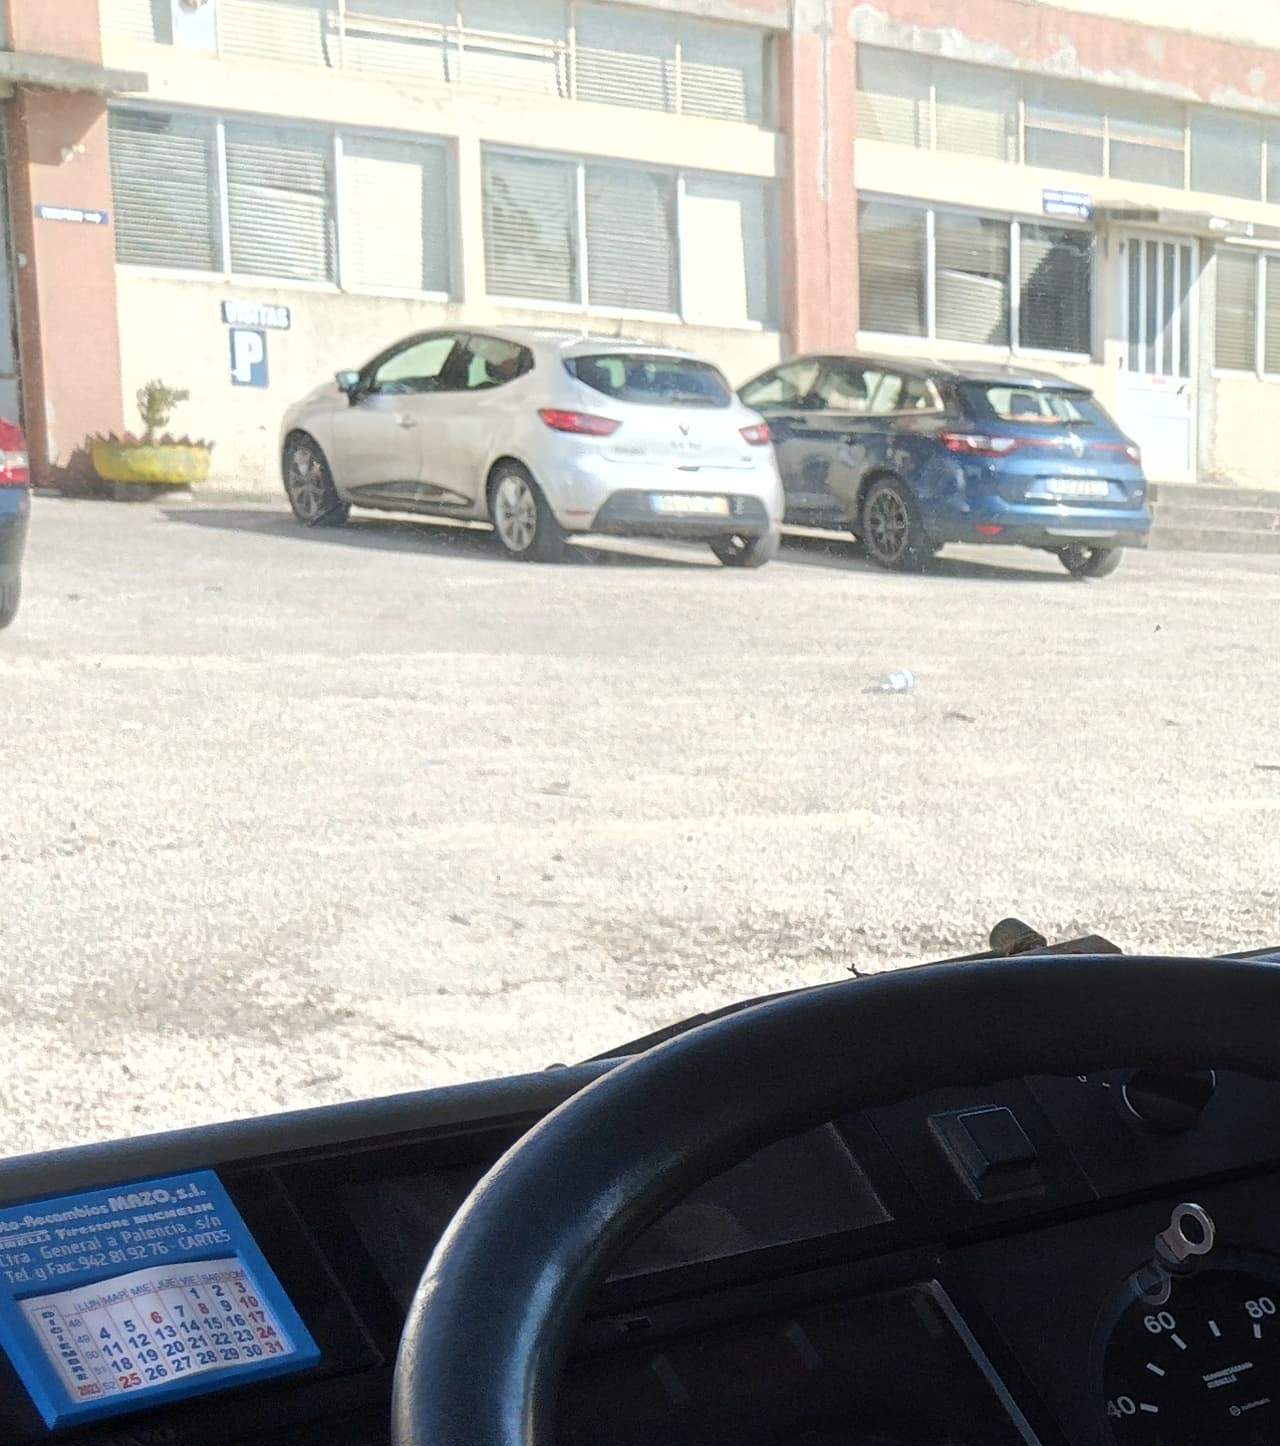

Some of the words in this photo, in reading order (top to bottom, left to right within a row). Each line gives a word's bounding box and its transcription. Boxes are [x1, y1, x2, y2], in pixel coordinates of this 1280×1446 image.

[232, 330, 263, 382] P
[35, 1268, 47, 1282] y
[78, 1252, 110, 1270] 942
[111, 1249, 126, 1263] 81
[129, 1246, 149, 1260] 92
[151, 1241, 169, 1255] 76
[179, 1229, 231, 1250] CARTES
[40, 1233, 102, 1260] General
[106, 1236, 117, 1248] a
[196, 1213, 222, 1231] s/n
[190, 1287, 200, 1299] 1
[212, 1284, 224, 1297] 2
[235, 1281, 247, 1293] 3
[1244, 1296, 1276, 1319] 80
[100, 1327, 111, 1339] 4
[123, 1320, 136, 1332] 5
[151, 1311, 163, 1324] 6
[174, 1305, 184, 1318] 7
[198, 1302, 209, 1314] 8
[220, 1300, 232, 1312] 9
[240, 1296, 259, 1309] 10
[103, 1341, 124, 1357] 11
[129, 1333, 150, 1348] 12
[155, 1325, 176, 1340] 13
[180, 1320, 200, 1333] 14
[203, 1316, 222, 1330] 15
[226, 1314, 246, 1327] 16
[249, 1310, 266, 1323] 17
[1143, 1310, 1177, 1334] 60
[111, 1357, 133, 1372] 18
[137, 1349, 158, 1364] 19
[163, 1341, 185, 1356] 20
[188, 1335, 208, 1349] 21
[211, 1332, 232, 1346] 22
[234, 1329, 254, 1342] 23
[256, 1326, 276, 1339] 24
[119, 1372, 142, 1389] 25
[145, 1365, 167, 1381] 26
[172, 1357, 192, 1372] 27
[196, 1350, 217, 1364] 28
[220, 1347, 239, 1360] 29
[242, 1344, 262, 1358] 30
[265, 1341, 285, 1354] 31
[1106, 1395, 1137, 1419] 40
